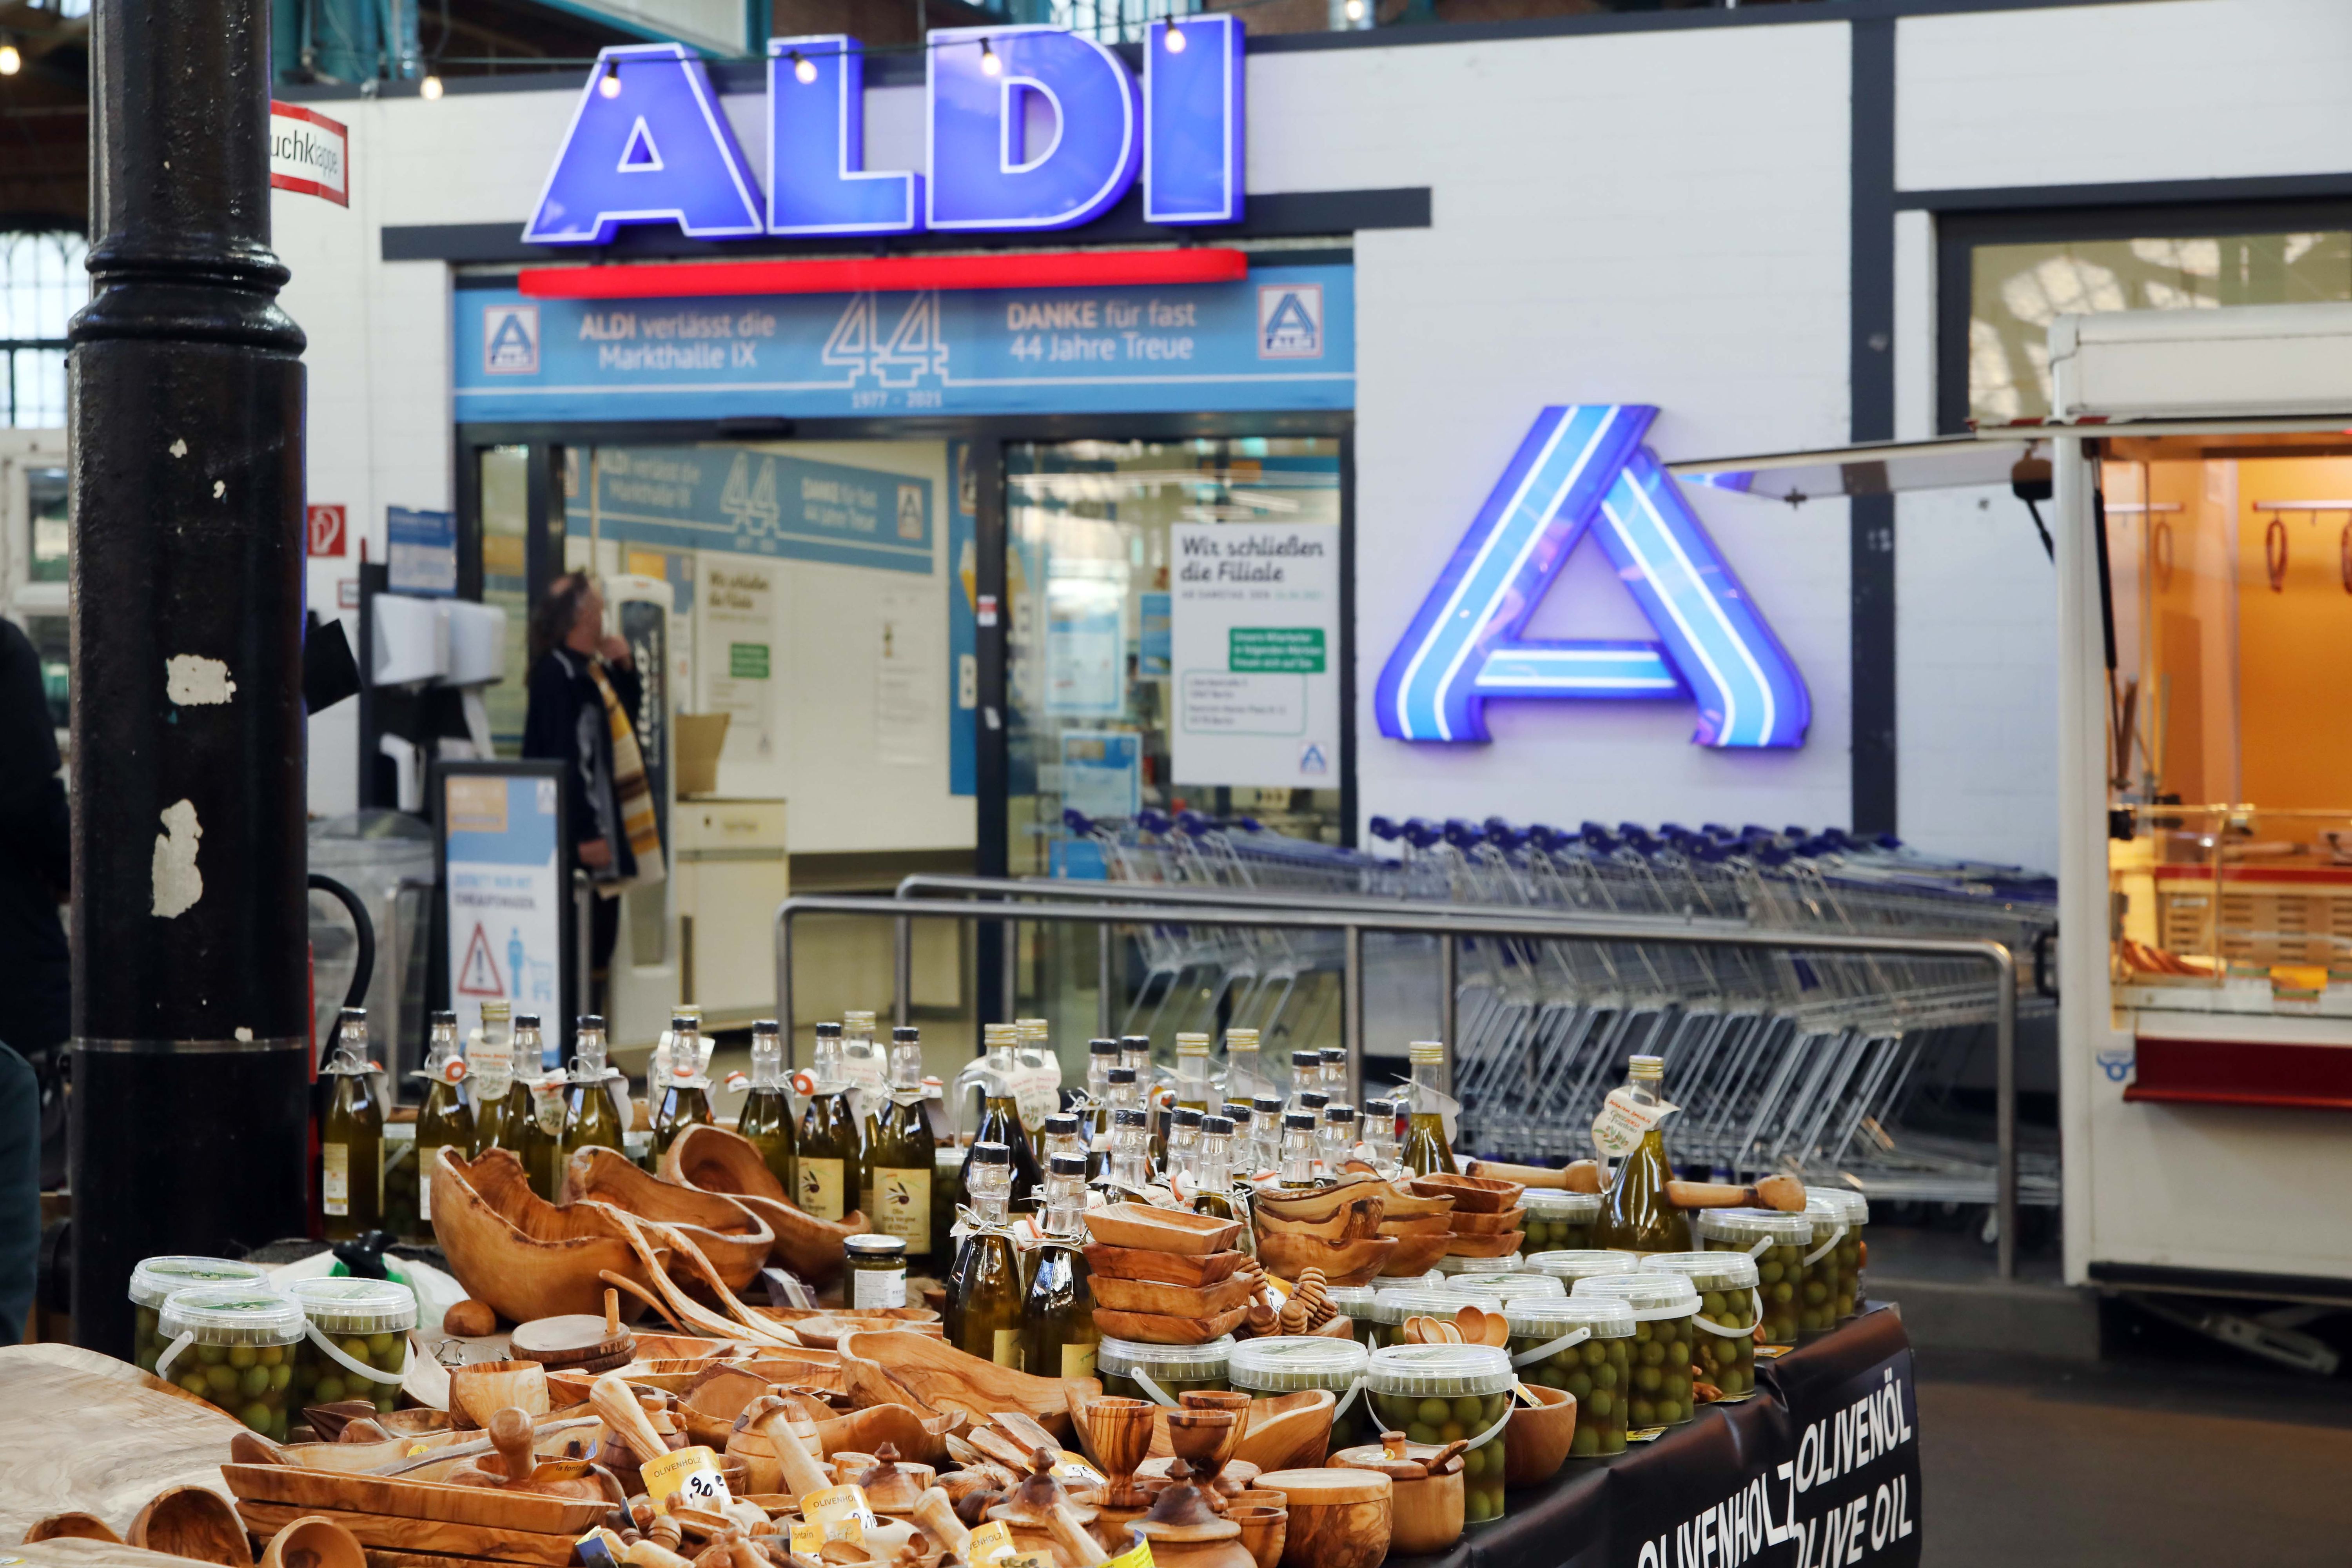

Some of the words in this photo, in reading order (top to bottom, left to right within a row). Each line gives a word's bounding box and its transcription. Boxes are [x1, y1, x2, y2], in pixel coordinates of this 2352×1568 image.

[522, 14, 1242, 244] ALDI
[270, 129, 338, 178] uchklappe
[579, 312, 636, 340] ALDI
[642, 312, 732, 339] verlässt
[738, 309, 776, 338] die
[1007, 299, 1097, 330] DANKE
[1105, 298, 1141, 328] für
[1149, 298, 1196, 328] fast
[599, 342, 725, 370] Markthalle
[732, 341, 757, 368] IX
[1010, 333, 1044, 362] 44
[1049, 332, 1116, 361] Jahre
[1122, 330, 1194, 360] Treue
[1181, 535, 1220, 557] Wir
[1227, 534, 1324, 557] schließen
[1180, 561, 1211, 582] die
[1218, 561, 1284, 582] Filiale
[1796, 1368, 1911, 1493] OLIVENÖL
[654, 1457, 702, 1477] OLIVENHOLZ
[1871, 1474, 1913, 1551] OIL
[966, 1533, 1003, 1552] IVENHOLZ
